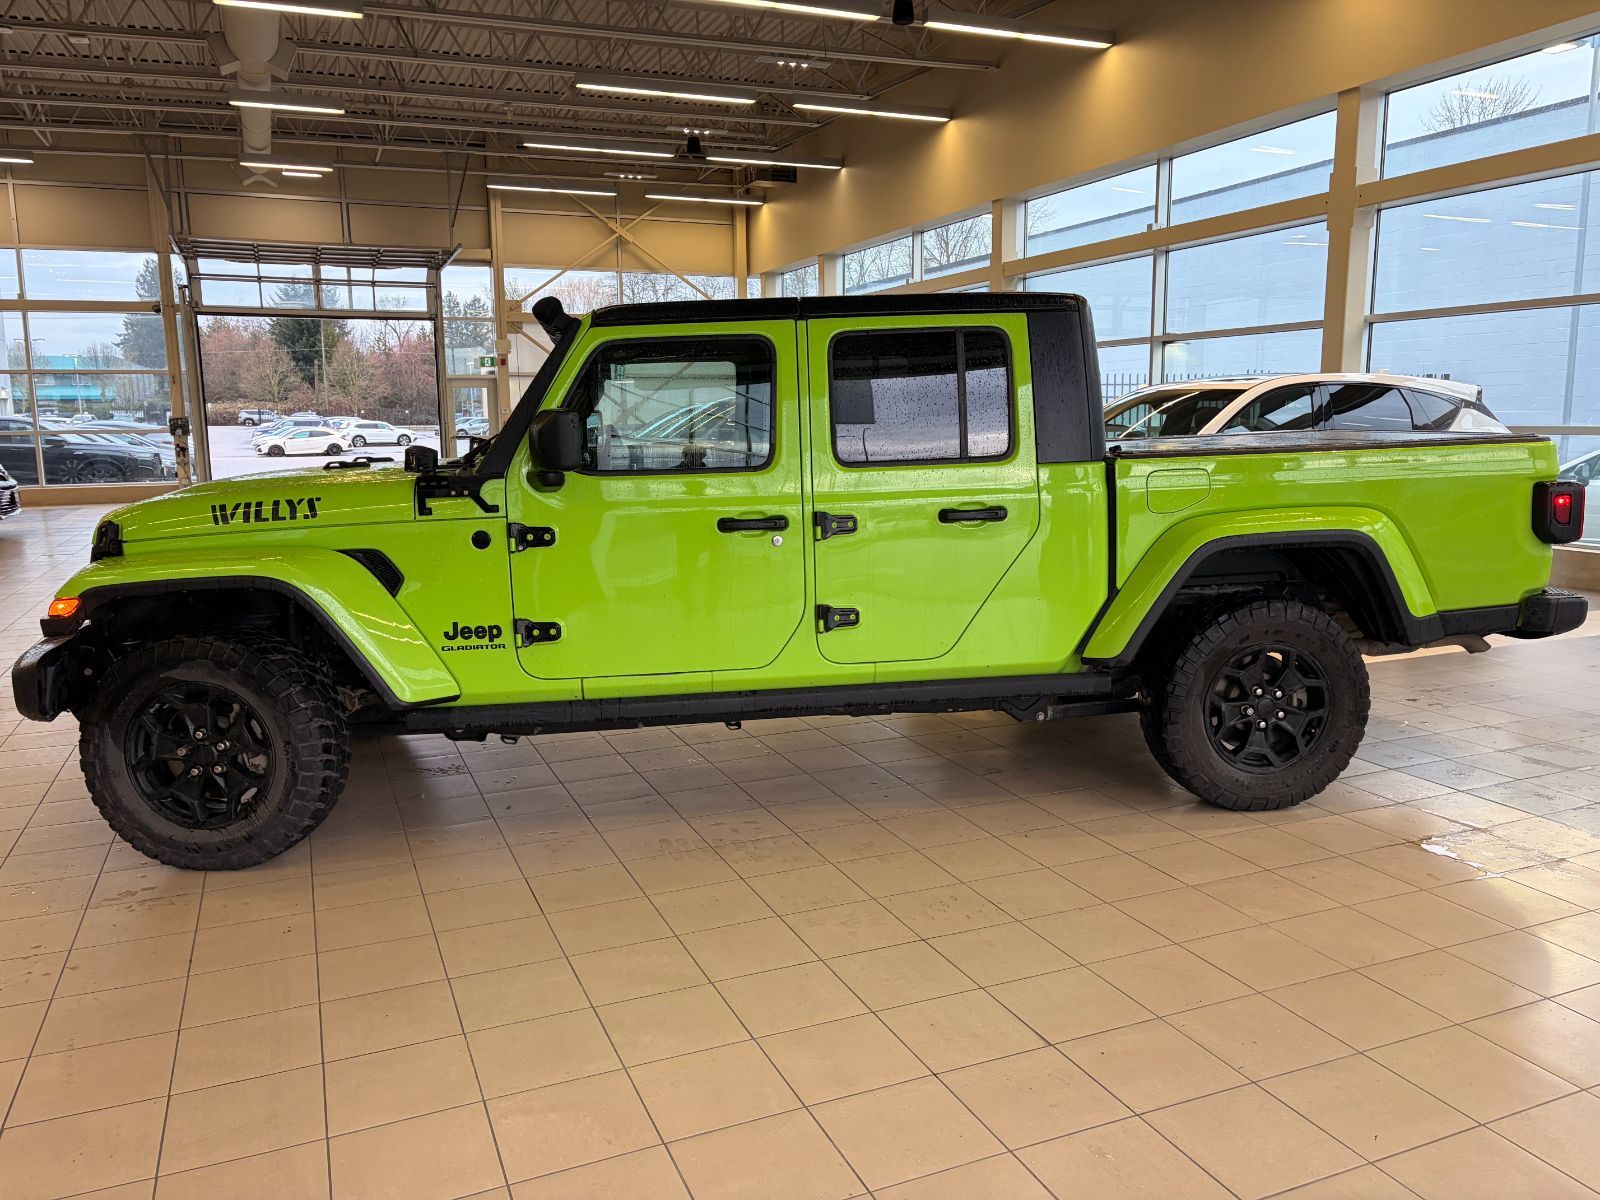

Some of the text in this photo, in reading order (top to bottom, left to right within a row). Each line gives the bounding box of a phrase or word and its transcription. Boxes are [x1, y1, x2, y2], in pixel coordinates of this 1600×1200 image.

[211, 497, 322, 525] WILLYS
[443, 622, 502, 642] Jeep
[441, 643, 506, 652] GLADIATOR
